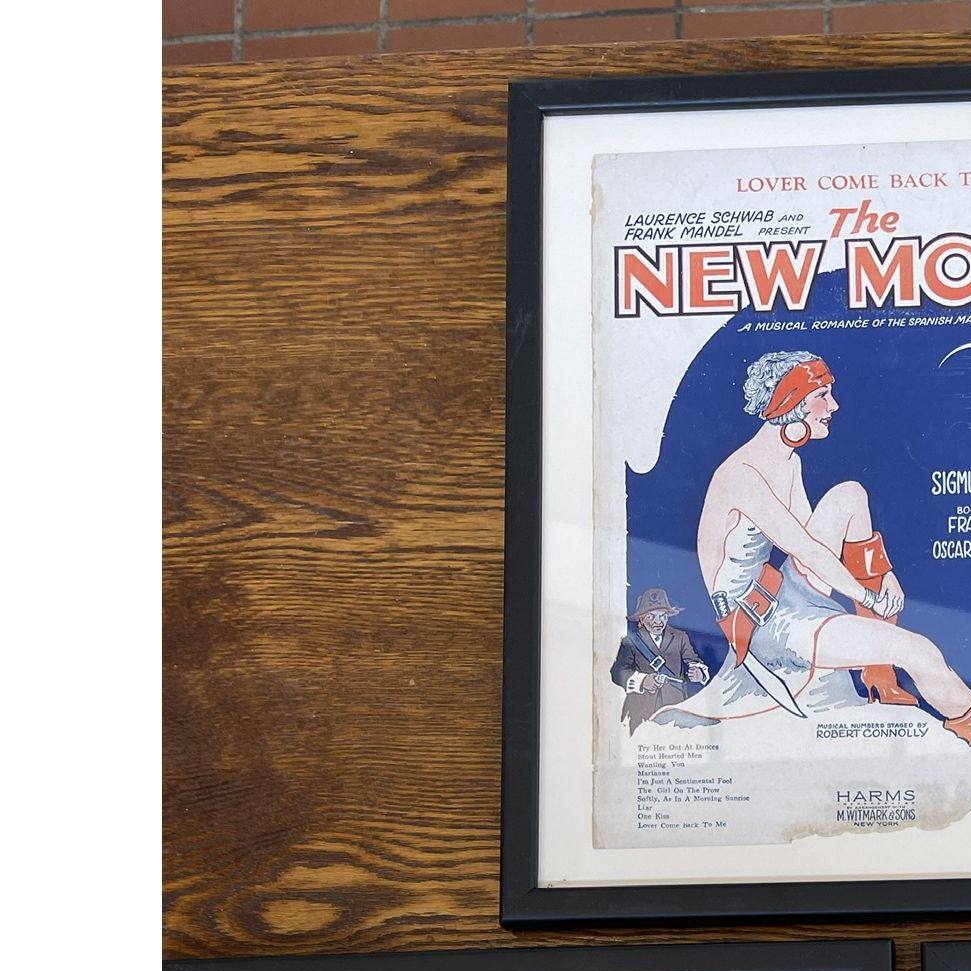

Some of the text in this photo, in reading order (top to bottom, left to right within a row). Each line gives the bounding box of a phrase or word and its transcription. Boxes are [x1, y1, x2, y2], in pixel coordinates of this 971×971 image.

[737, 177, 807, 193] LOVER
[818, 174, 880, 191] COME
[890, 172, 949, 190] BACK
[625, 209, 804, 227] LAURENCE SCHWAB AND
[829, 199, 900, 238] The
[625, 225, 812, 241] FRANK MANDEL PRESENT
[614, 239, 827, 318] NEW
[738, 323, 752, 331] A
[755, 321, 808, 331] MUSICAL
[811, 319, 869, 330] ROMANCE
[872, 318, 887, 327] OF
[887, 318, 907, 327] THE
[907, 315, 953, 326] SPANISH
[816, 728, 929, 739] ROBERT CONNOLLY
[837, 789, 917, 803] HARMS
[895, 808, 917, 821] SONS
